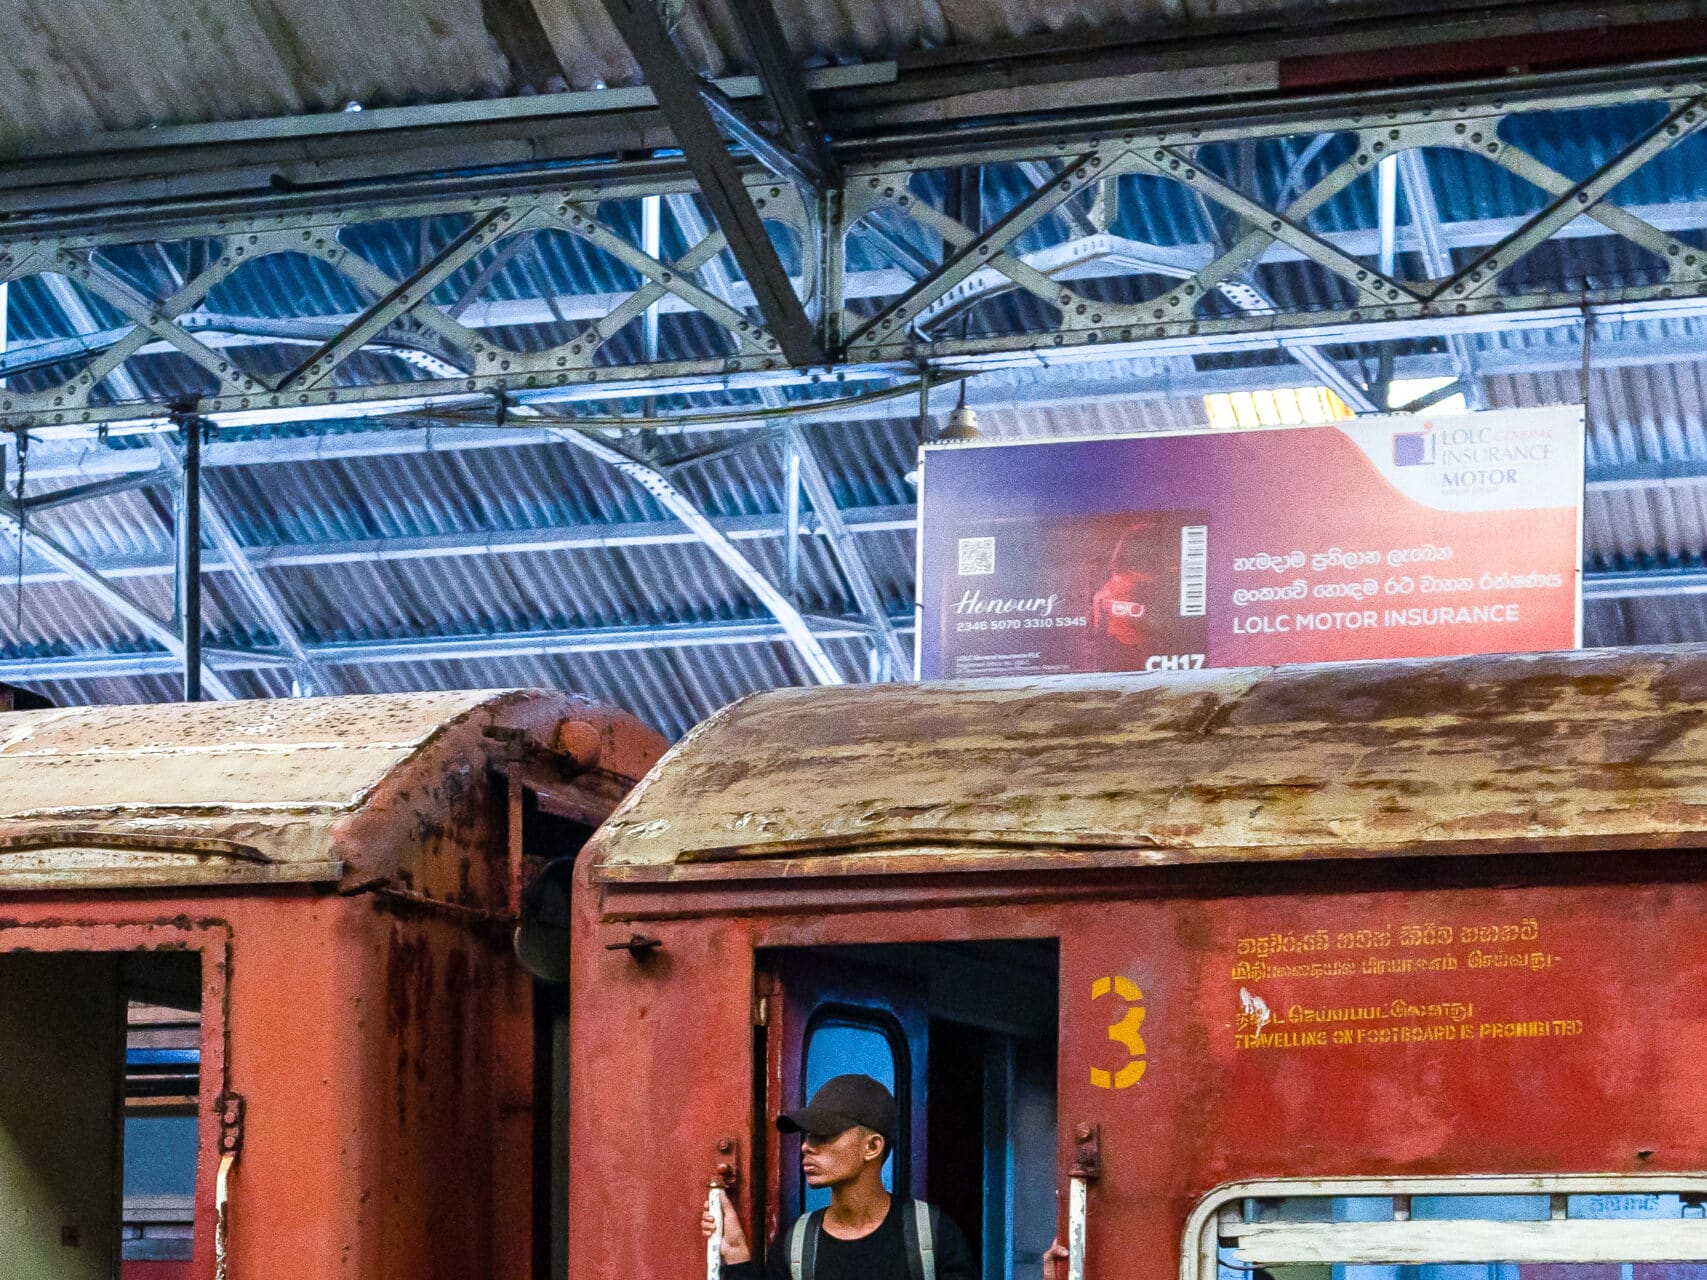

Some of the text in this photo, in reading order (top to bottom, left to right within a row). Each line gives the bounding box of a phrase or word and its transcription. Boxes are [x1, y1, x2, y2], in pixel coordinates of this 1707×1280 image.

[1442, 427, 1492, 445] LOLC
[1442, 445, 1552, 464] INSURANCE
[1441, 469, 1518, 487] MOTOR
[950, 589, 1065, 617] Honours
[991, 620, 1021, 630] 5070
[1023, 618, 1053, 628] 3310
[1056, 617, 1087, 627] 5345
[1233, 604, 1520, 634] LOLC MOTOR INSURANCE
[1145, 654, 1206, 671] CH17
[1090, 975, 1147, 1089] 3
[1235, 1031, 1328, 1049] TRAVELLING
[1333, 1029, 1353, 1044] ON
[1461, 1024, 1475, 1039] IS
[1479, 1019, 1583, 1040] PROHIBITED
